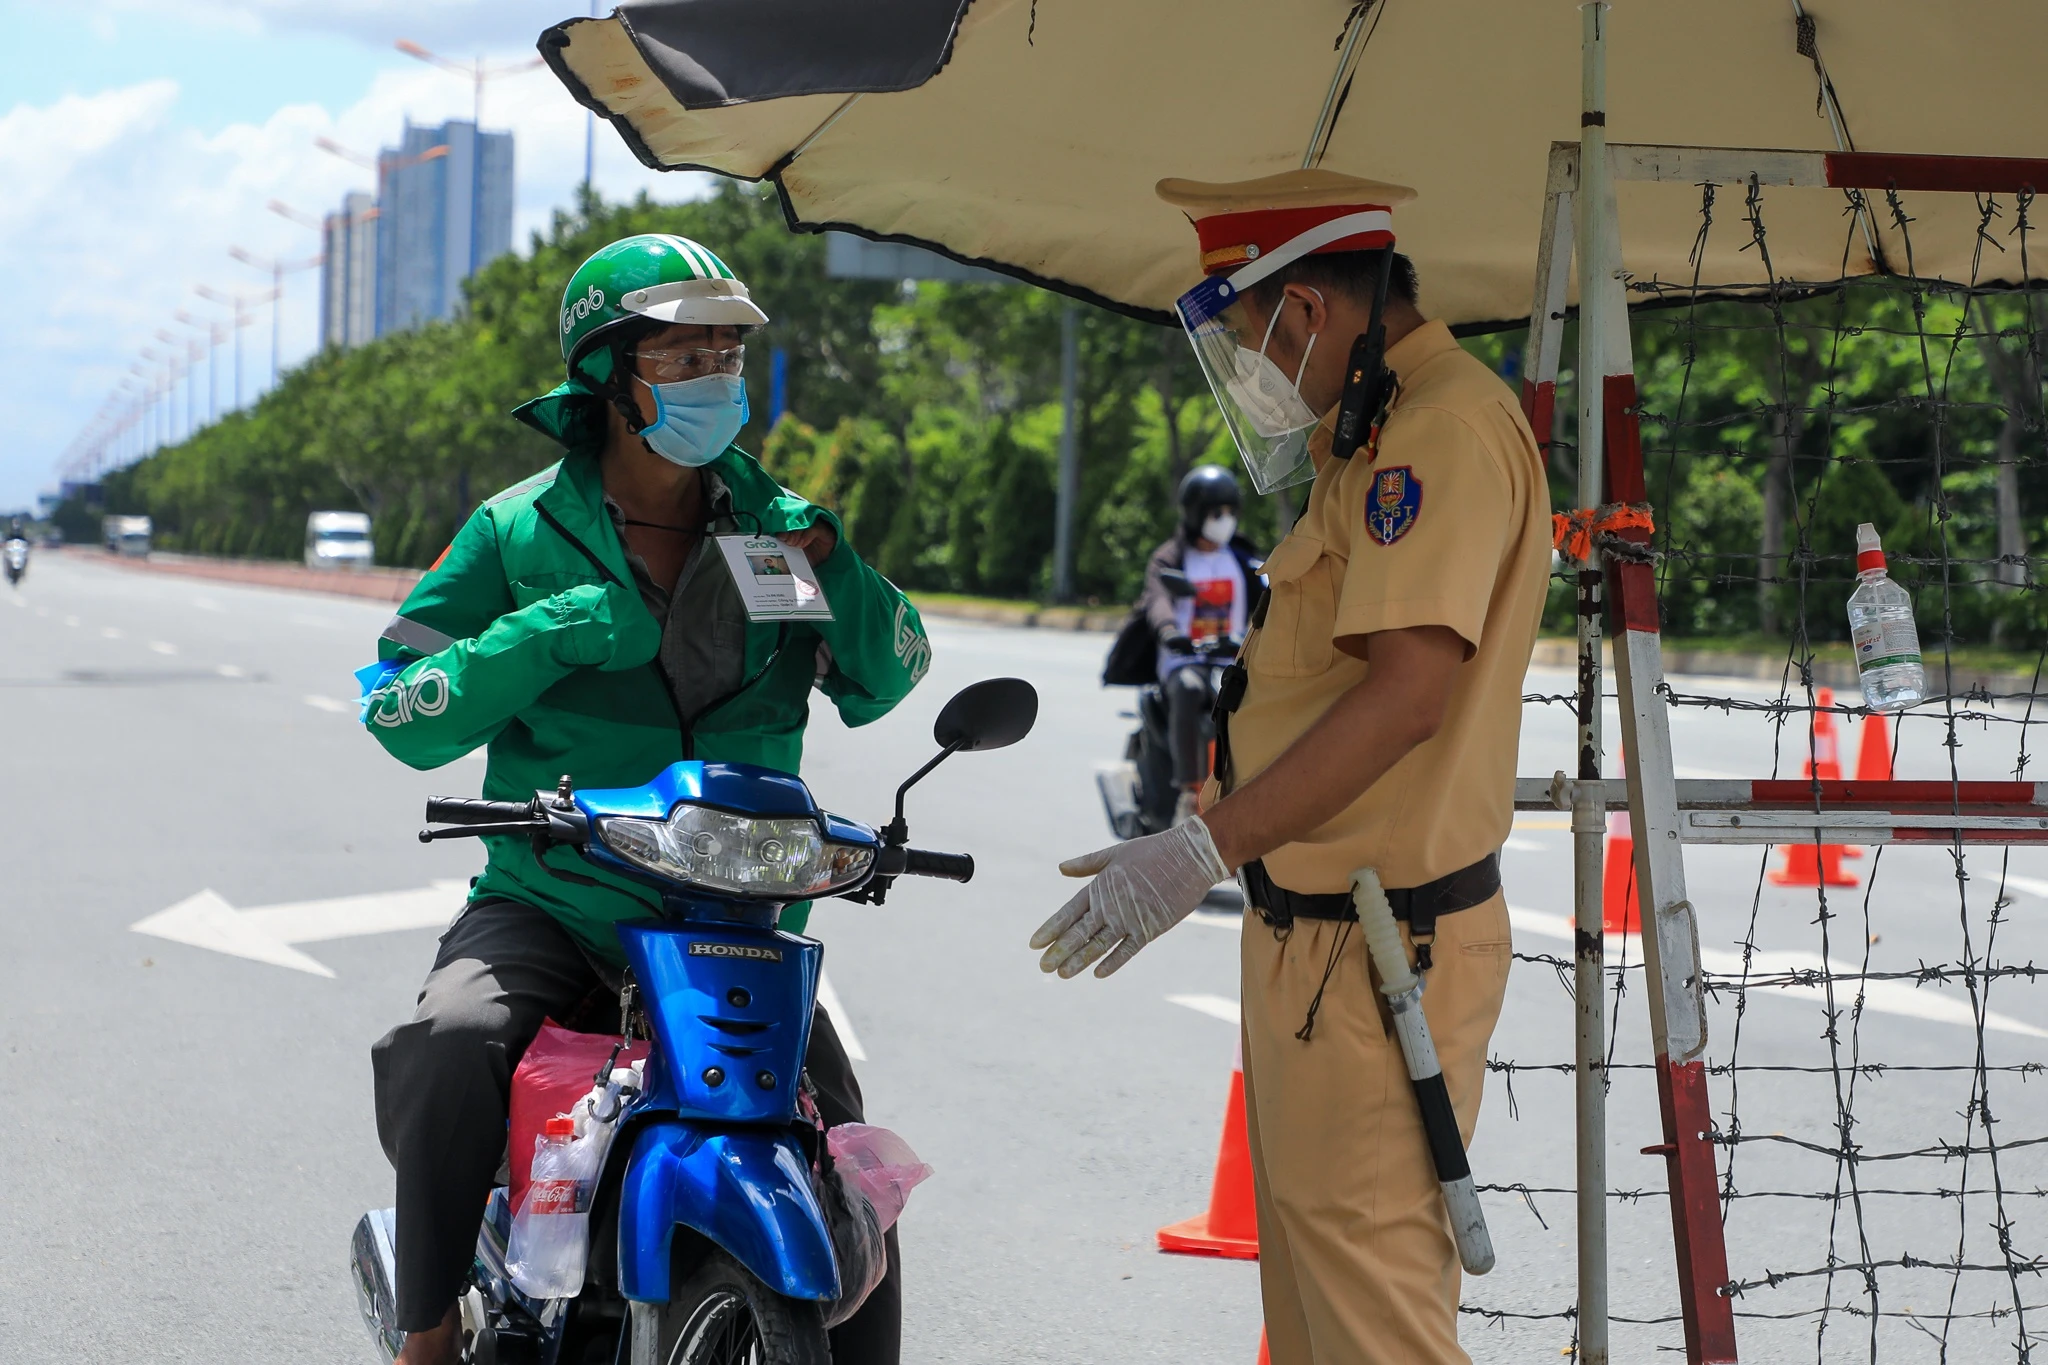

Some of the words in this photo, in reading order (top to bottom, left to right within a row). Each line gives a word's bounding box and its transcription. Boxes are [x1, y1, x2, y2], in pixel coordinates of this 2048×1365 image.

[563, 285, 604, 334] Grab
[1369, 505, 1413, 522] CSGT
[744, 541, 777, 549] Grab
[894, 600, 932, 684] Gra
[693, 944, 778, 960] HONDA
